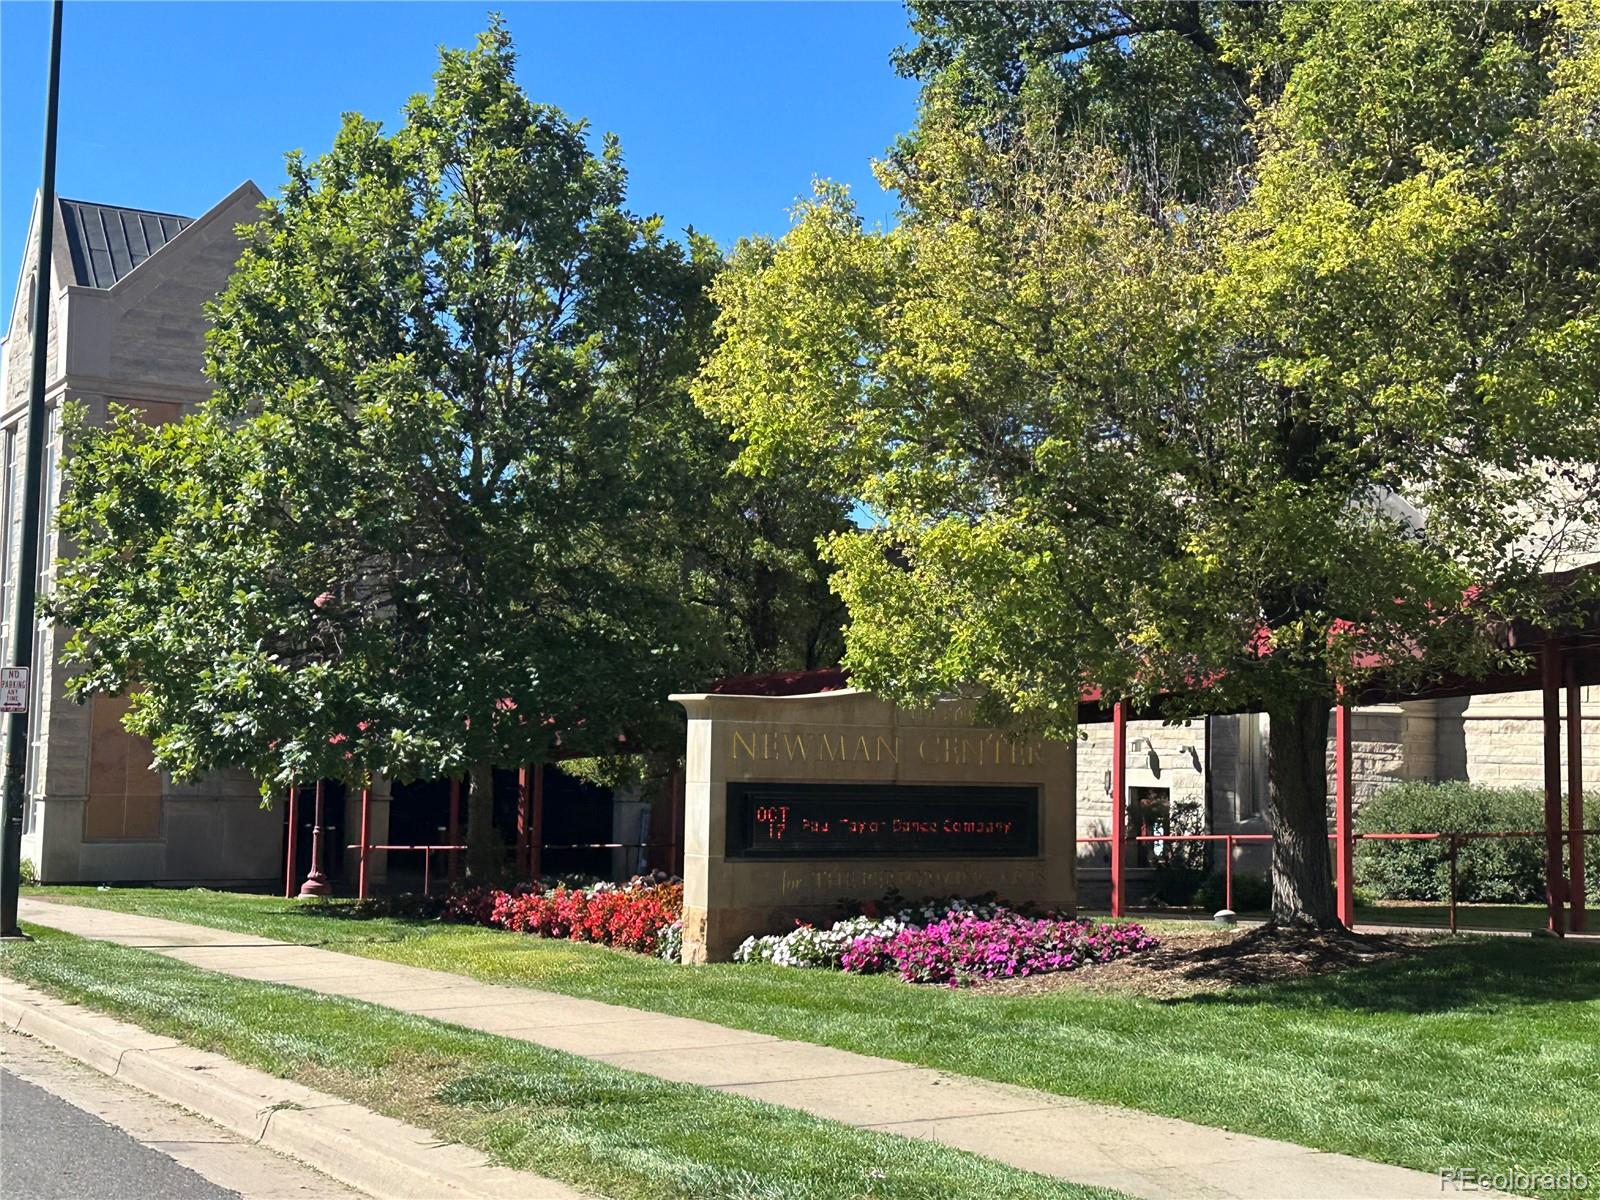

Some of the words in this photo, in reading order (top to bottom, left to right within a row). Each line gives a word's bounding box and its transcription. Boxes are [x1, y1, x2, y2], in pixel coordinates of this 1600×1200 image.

[8, 670, 20, 679] NO
[1, 680, 26, 688] PARKING
[731, 730, 899, 763] NEWMAN
[918, 732, 1049, 767] CENTER
[757, 806, 790, 822] OCT
[768, 823, 786, 839] 17
[802, 818, 833, 833] Pau
